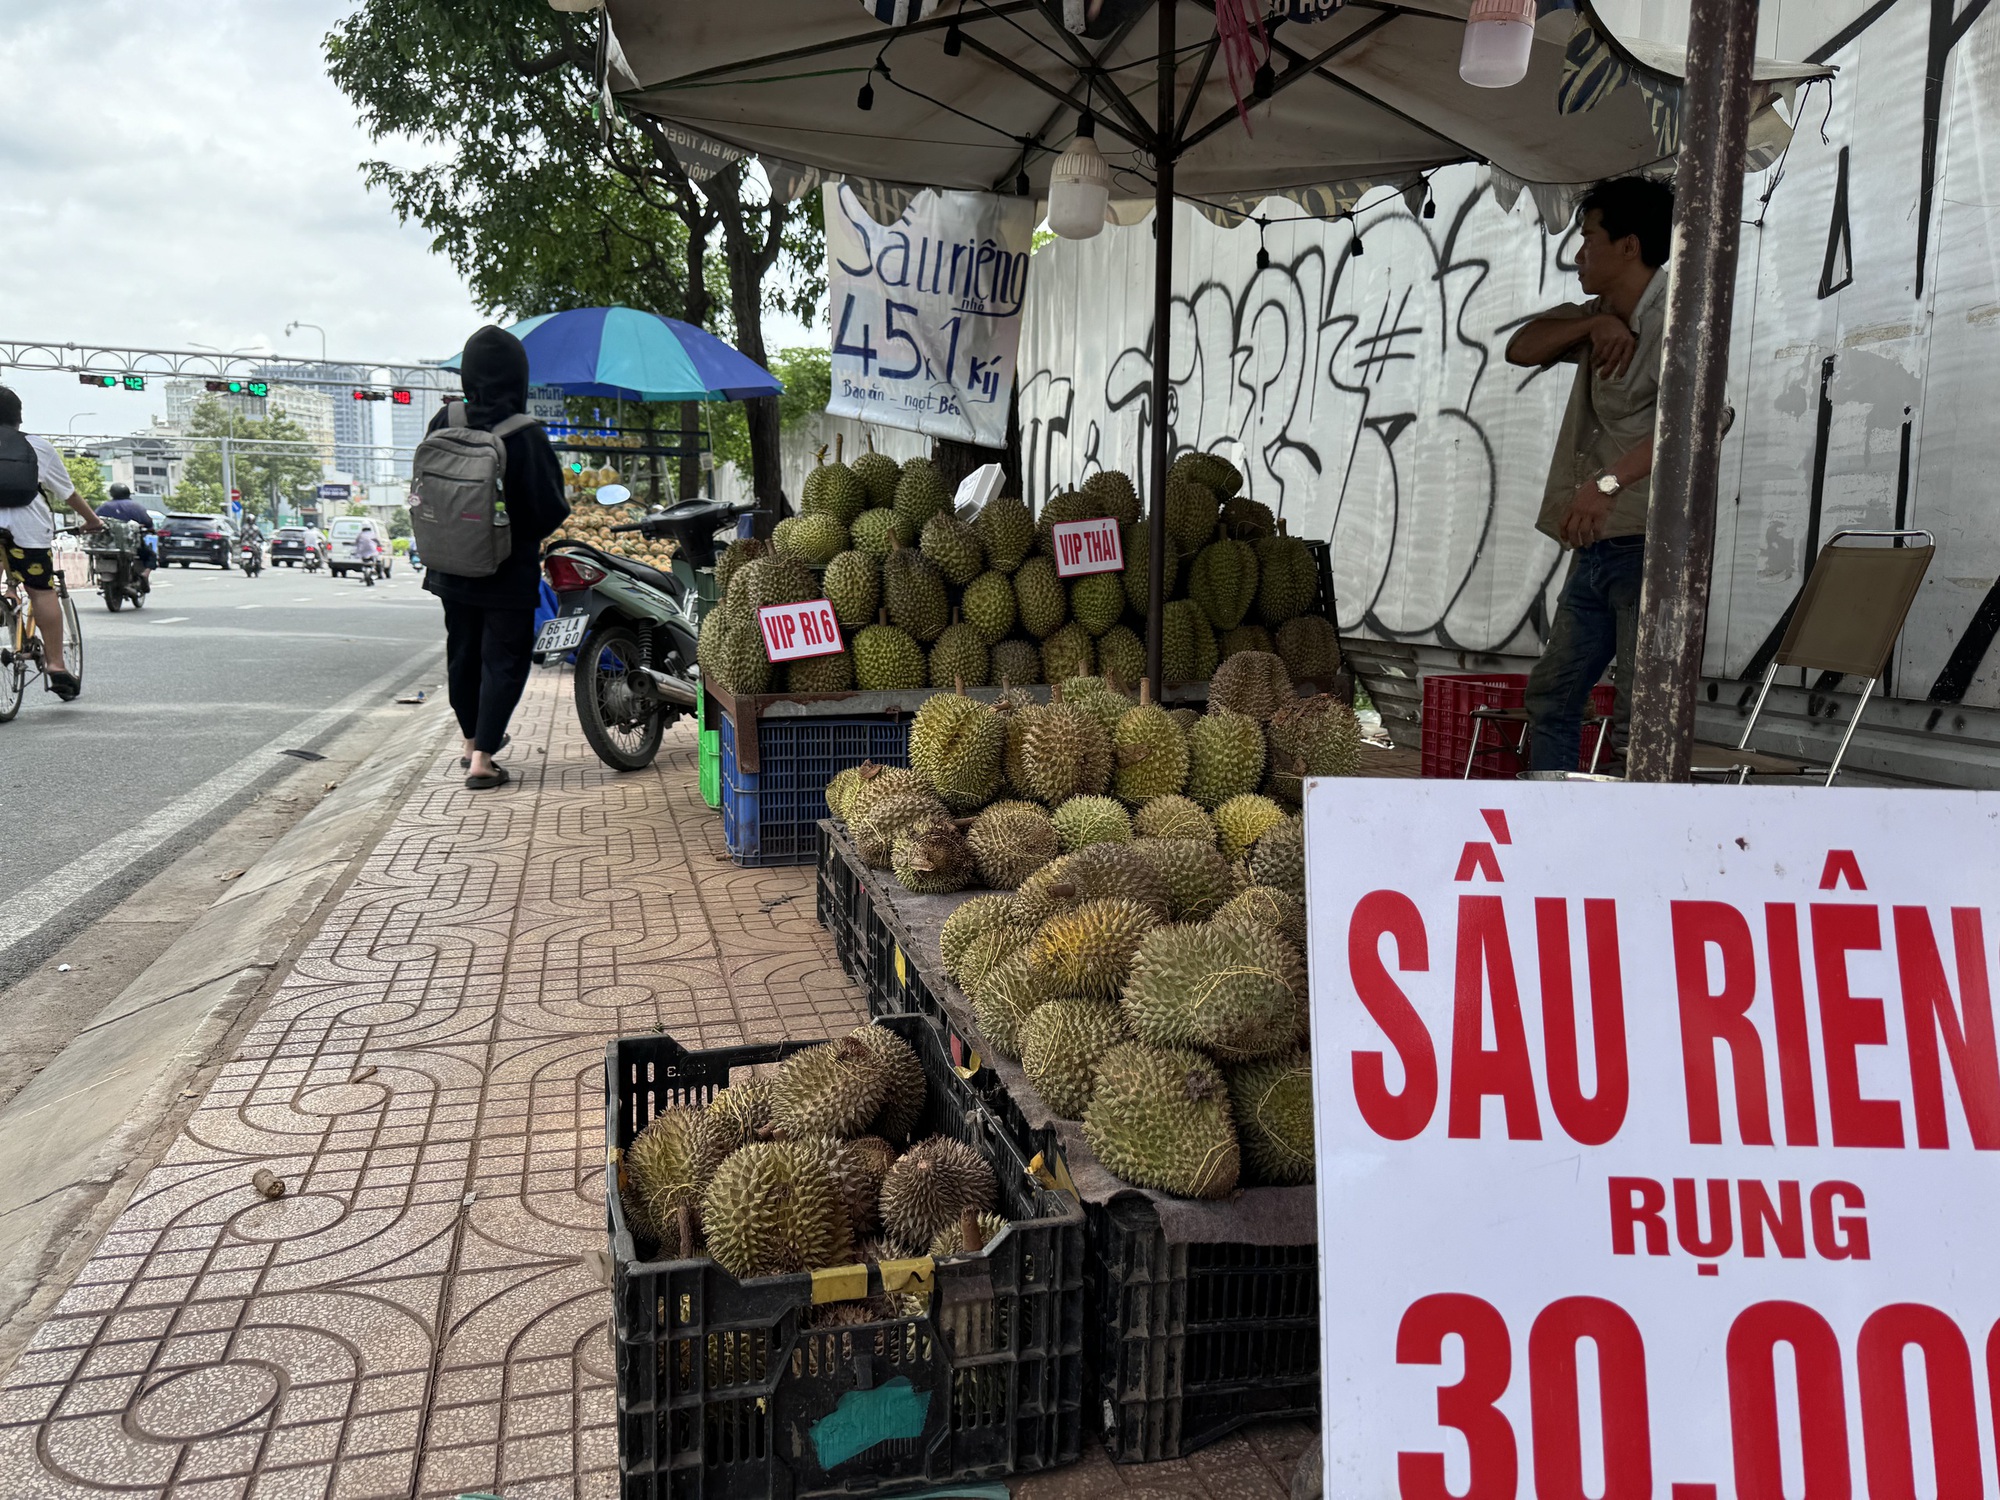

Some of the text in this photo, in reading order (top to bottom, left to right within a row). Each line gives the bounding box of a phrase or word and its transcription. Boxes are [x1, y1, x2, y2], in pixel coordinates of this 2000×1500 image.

[125, 377, 143, 390] 42
[248, 383, 267, 397] 42
[1059, 523, 1117, 566] VIP THÁI
[537, 632, 579, 650] 081.80
[546, 618, 580, 635] 66-LA
[764, 614, 796, 650] VIP
[1346, 807, 2000, 1152] SẦU RIÊN
[1607, 1176, 1871, 1276] RỤNG
[1395, 1292, 2000, 1500] 30.00
